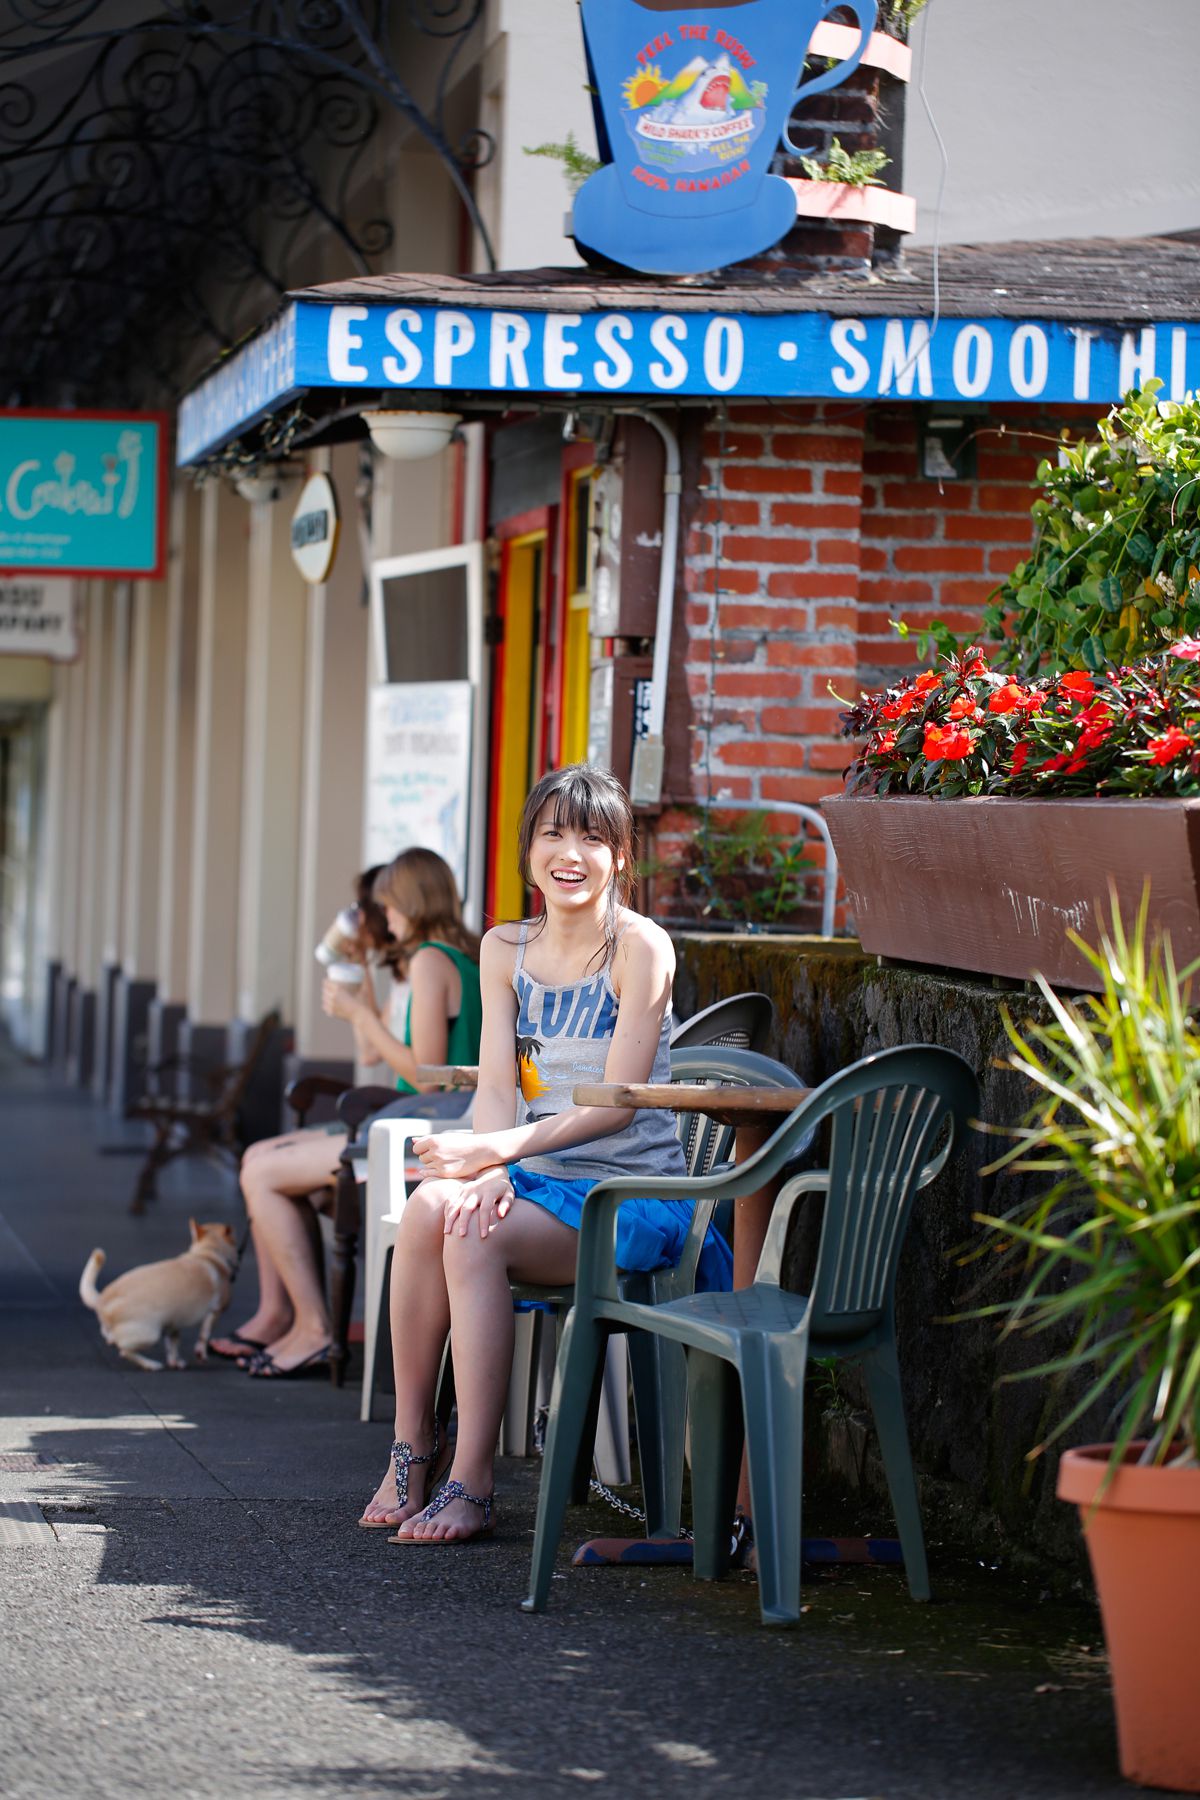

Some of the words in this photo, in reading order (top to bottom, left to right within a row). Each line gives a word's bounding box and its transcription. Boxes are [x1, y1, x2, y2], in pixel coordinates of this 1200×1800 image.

[636, 32, 674, 65] FEEL
[678, 25, 710, 41] THE
[711, 117, 751, 138] COFFEE
[327, 305, 744, 392] ESPRESSO
[830, 318, 1187, 401] SMOOTHI
